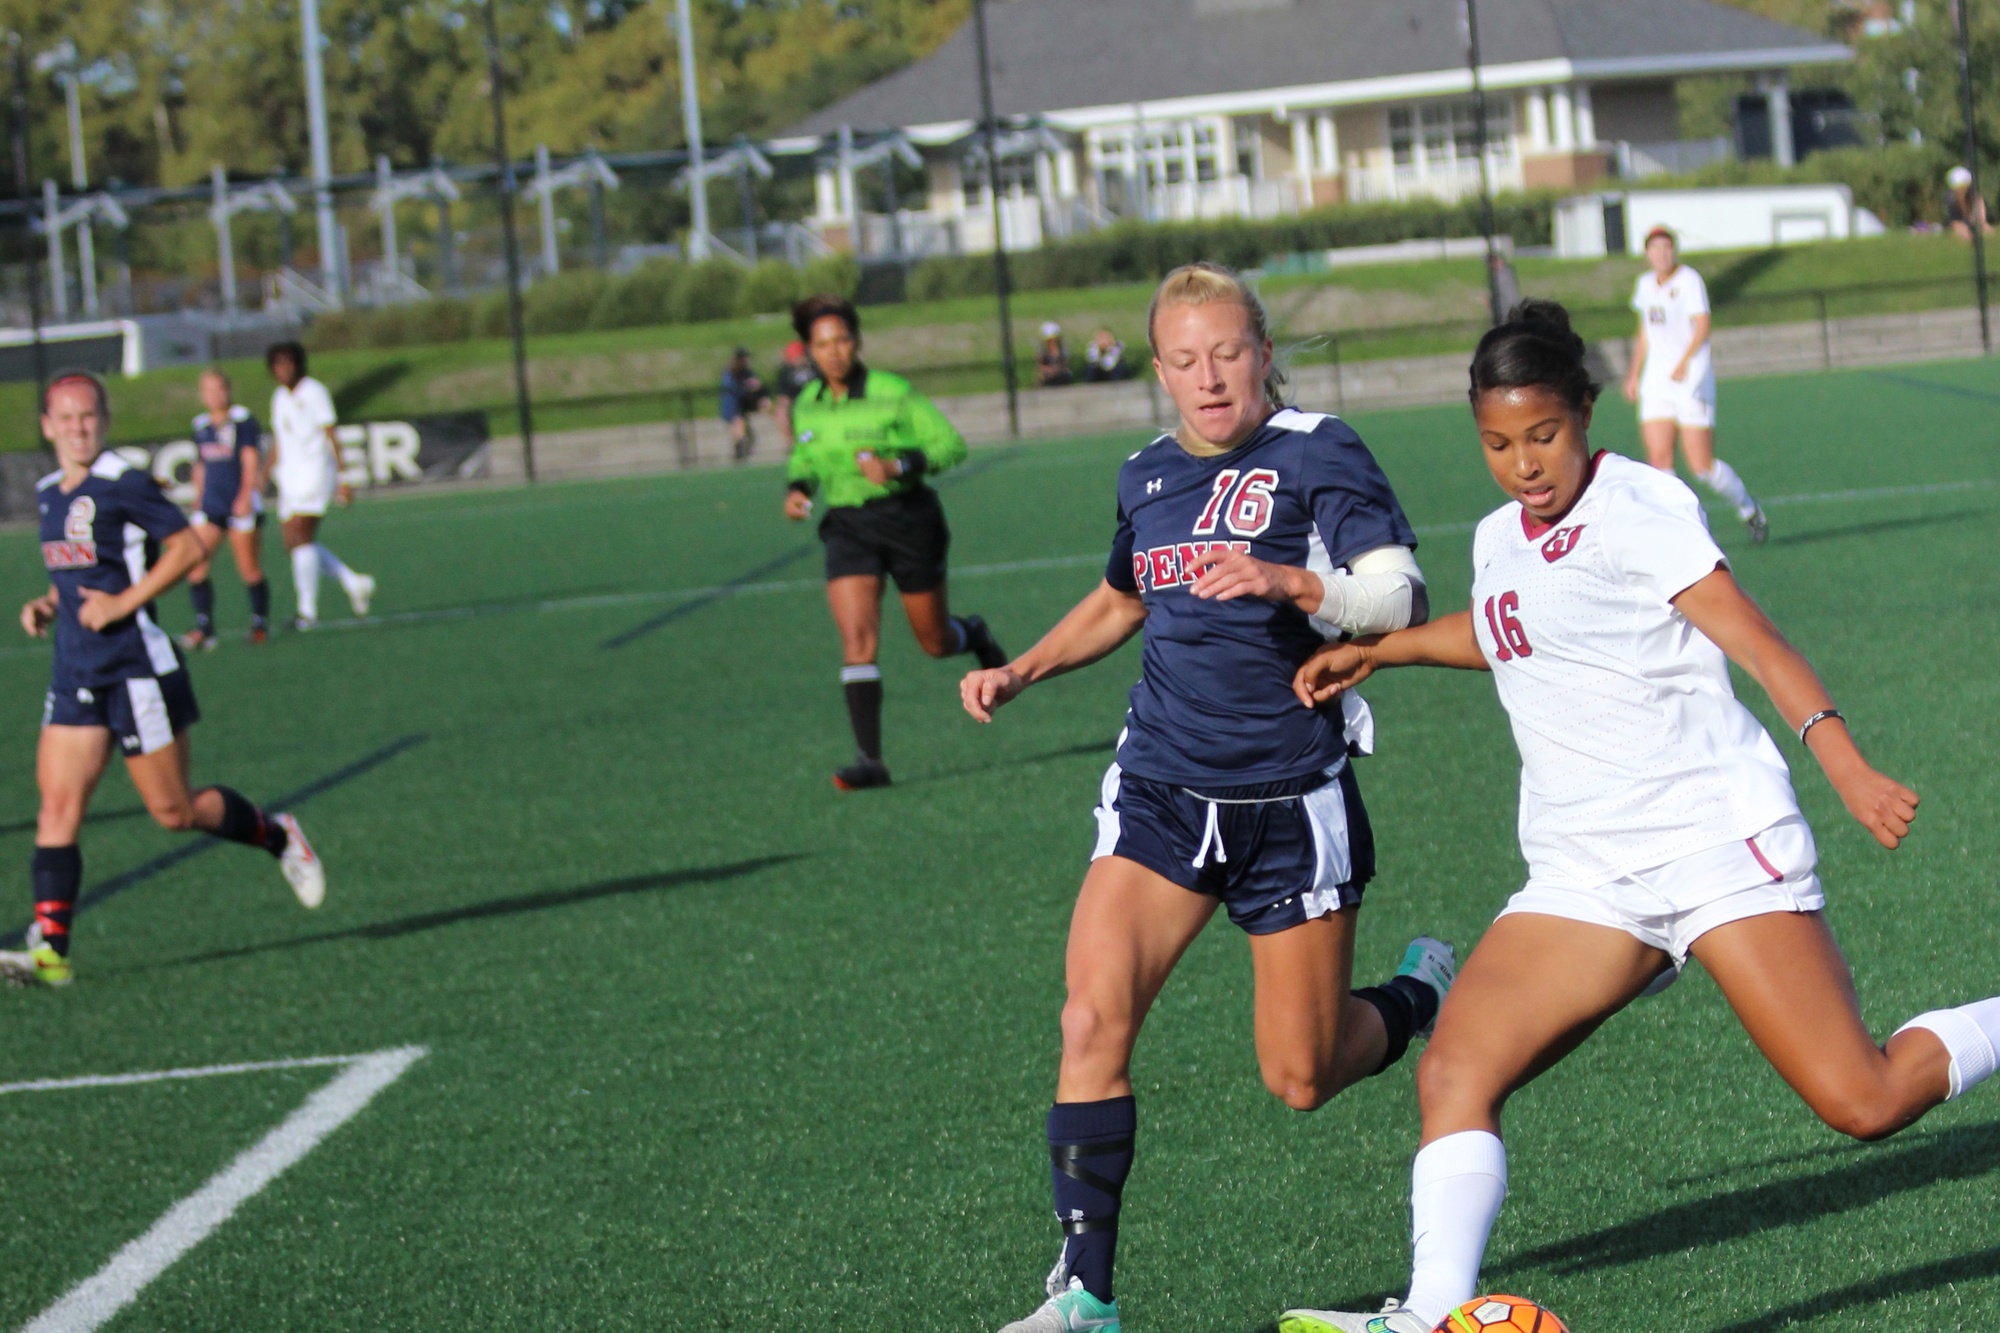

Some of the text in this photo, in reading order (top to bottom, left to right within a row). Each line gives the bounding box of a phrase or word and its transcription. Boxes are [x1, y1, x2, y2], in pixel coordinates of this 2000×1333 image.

[64, 495, 96, 543] 2
[1192, 467, 1280, 538] 16
[1133, 541, 1251, 593] PEN
[1485, 590, 1533, 662] 16
